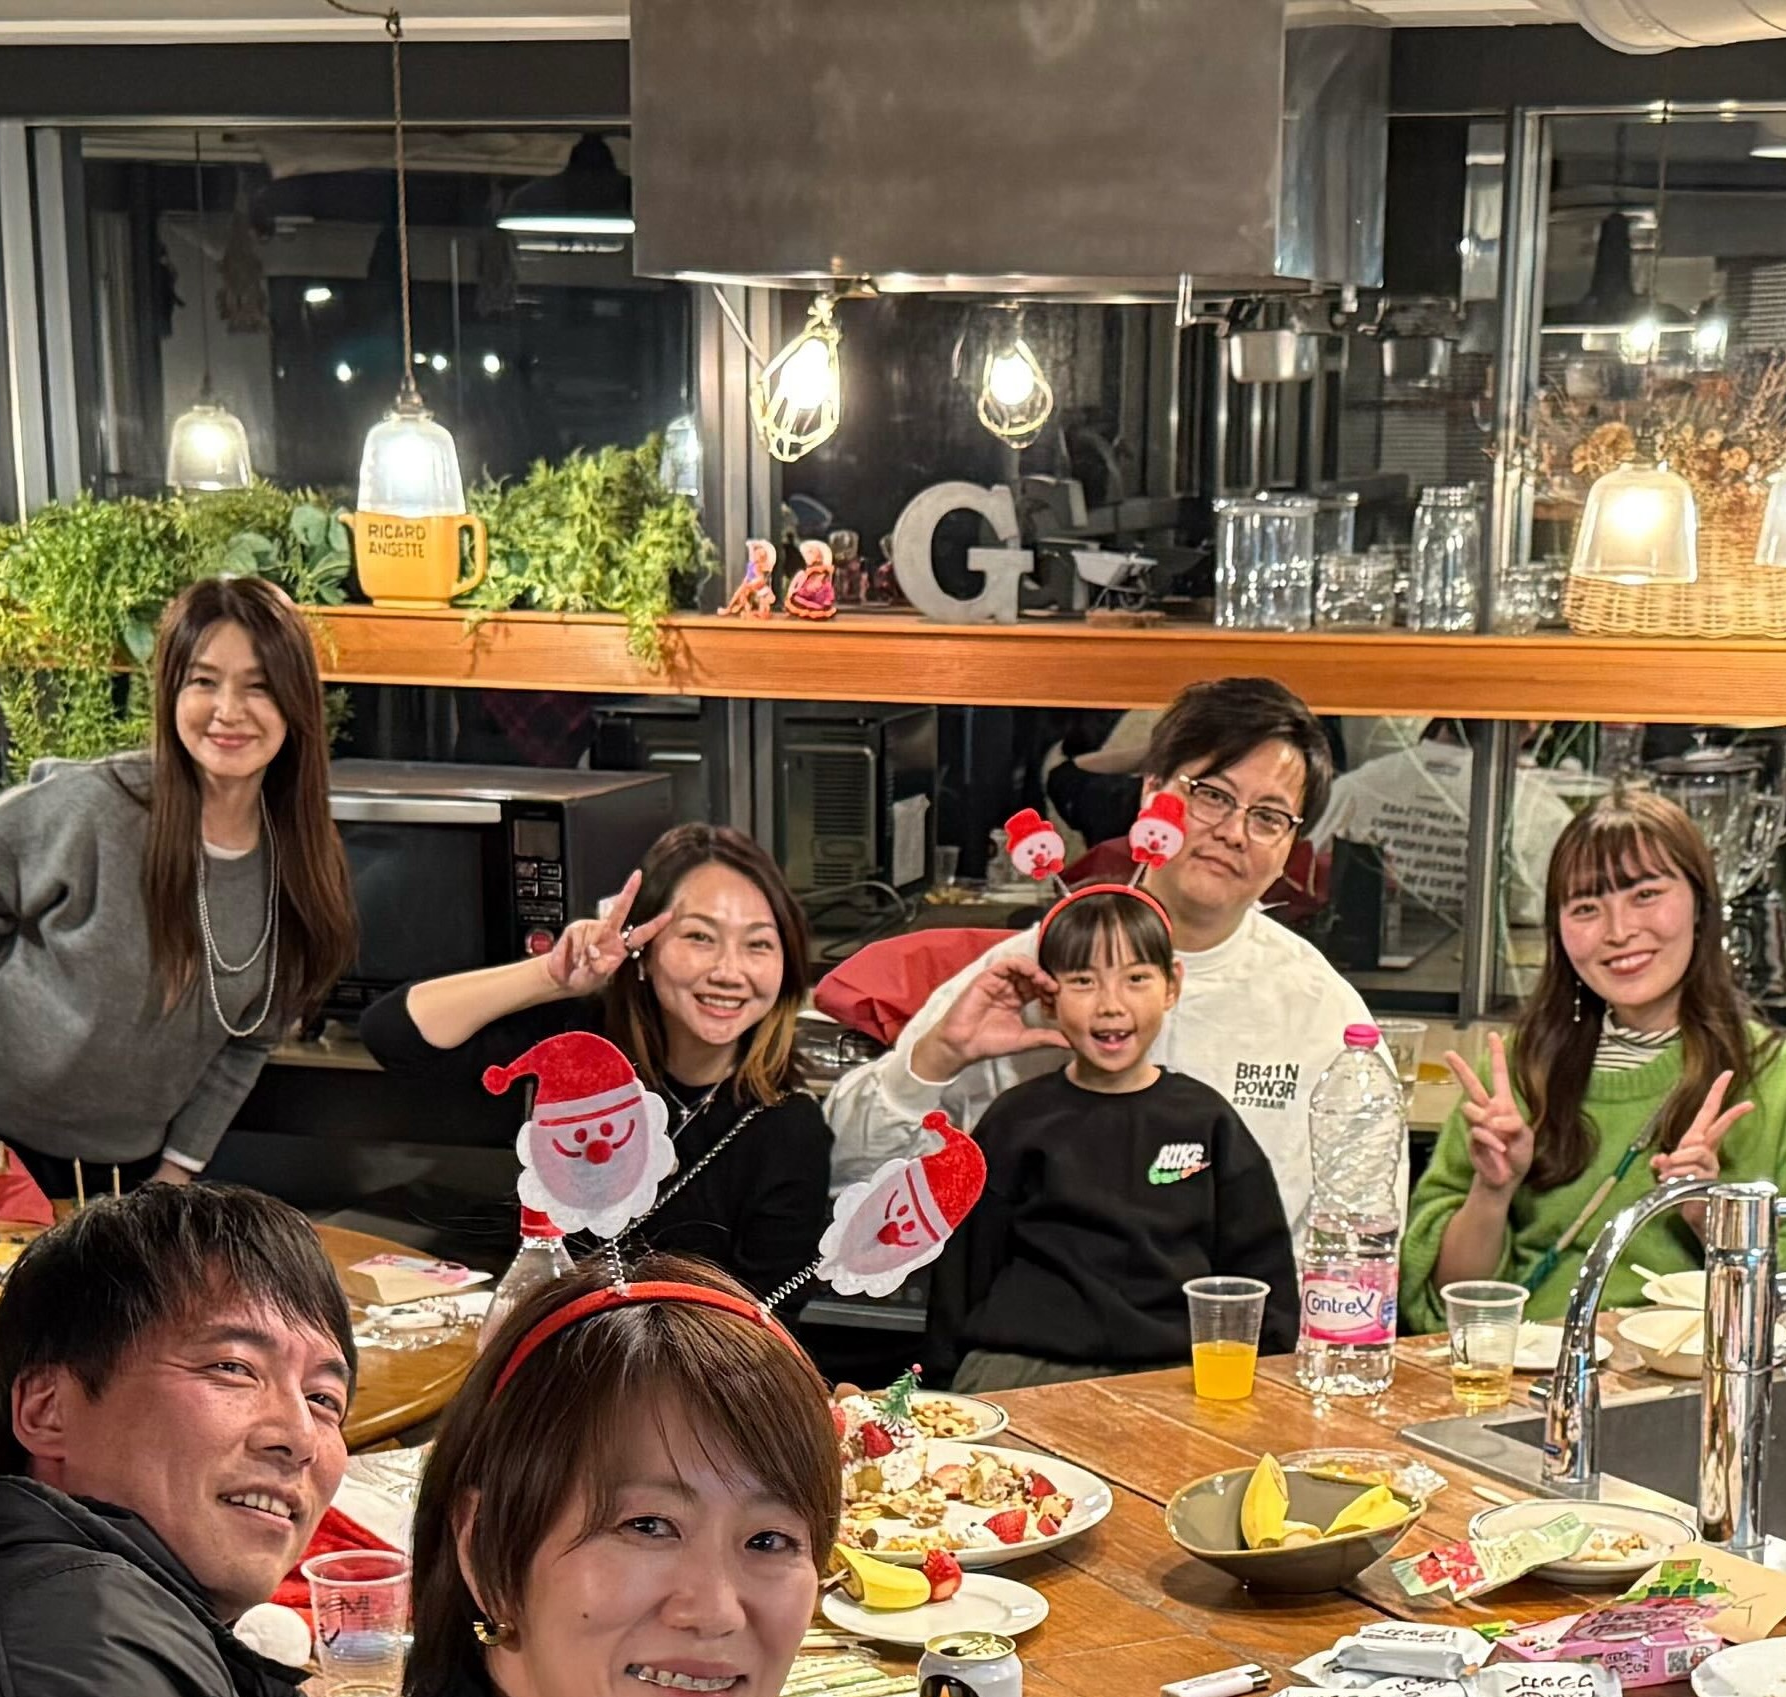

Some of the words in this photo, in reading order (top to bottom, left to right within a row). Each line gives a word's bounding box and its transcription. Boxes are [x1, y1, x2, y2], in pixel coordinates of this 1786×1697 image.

[368, 523, 426, 540] RICARD
[894, 481, 1034, 624] G
[1234, 1080, 1297, 1100] POW3R
[1156, 1143, 1205, 1169] NIKE
